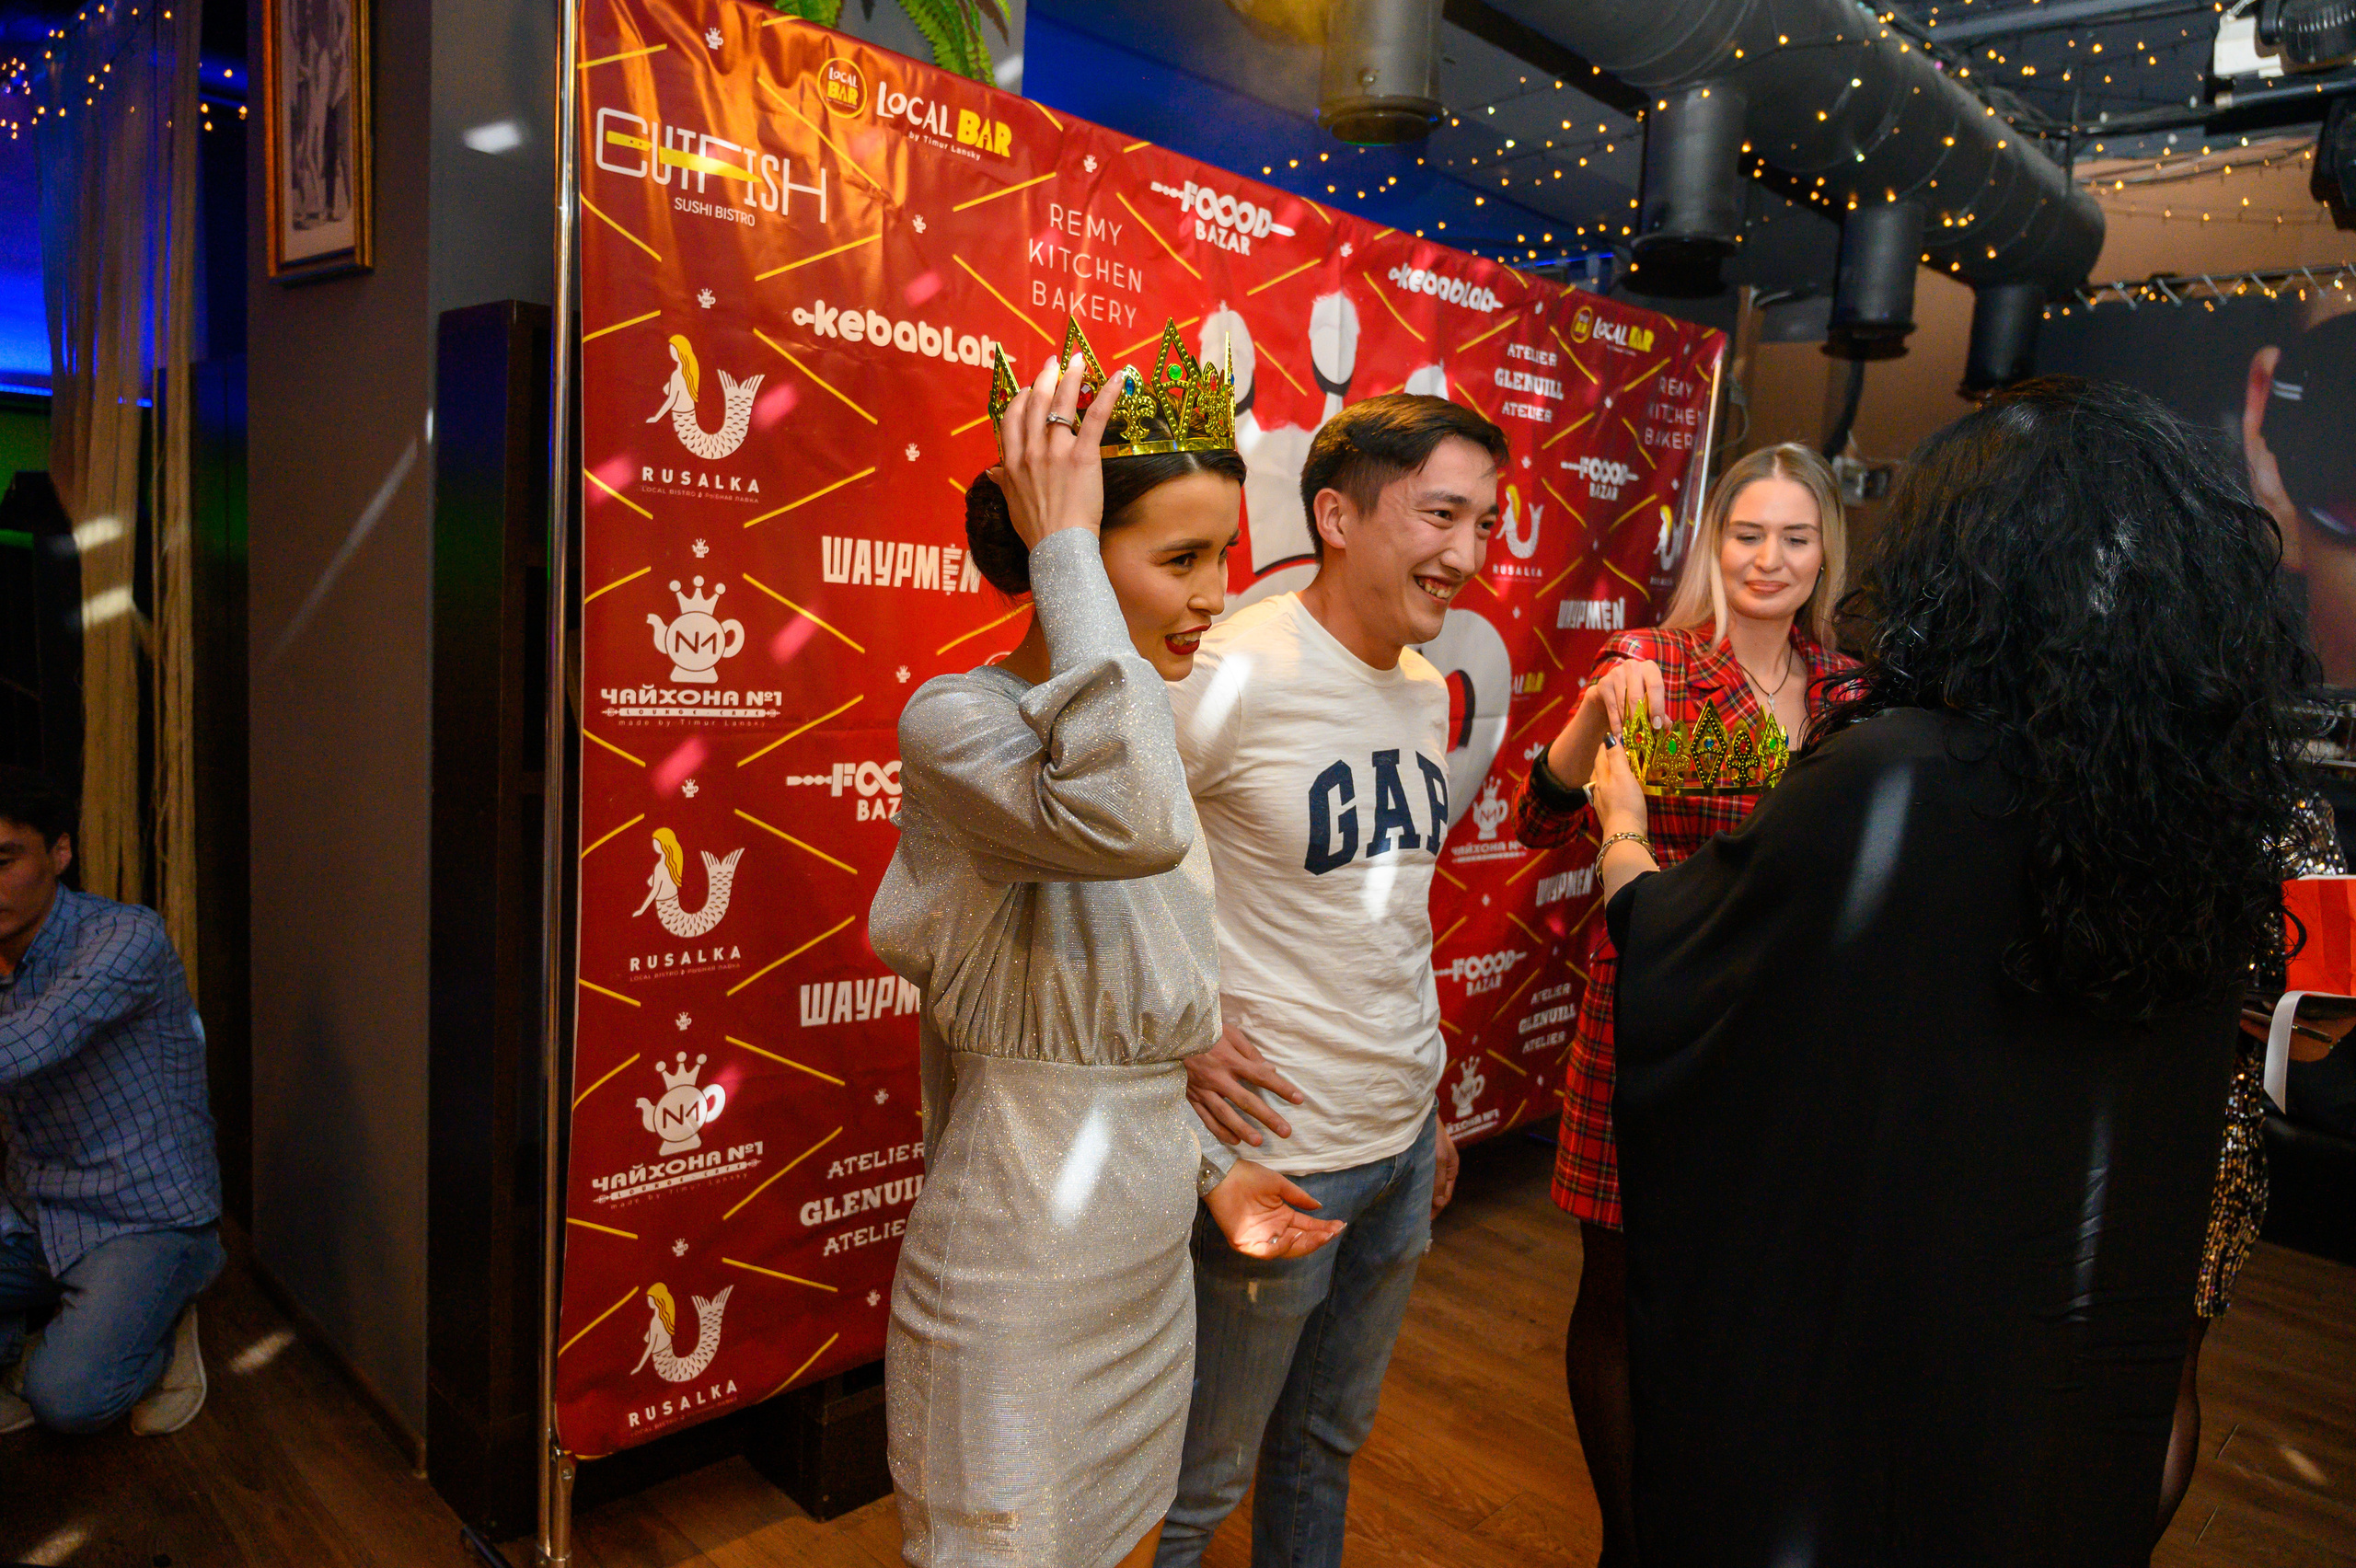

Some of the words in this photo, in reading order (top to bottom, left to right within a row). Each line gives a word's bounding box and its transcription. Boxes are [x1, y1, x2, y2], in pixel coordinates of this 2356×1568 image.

[829, 67, 858, 87] LOCAL
[827, 80, 859, 106] BAR
[877, 81, 953, 138] LOCAL
[956, 109, 1012, 158] BAR
[908, 131, 919, 142] by
[923, 135, 949, 150] Timur
[951, 144, 981, 161] Lansky
[675, 197, 712, 218] SUSHI
[715, 205, 756, 227] BISTRO
[1050, 203, 1122, 246] REMY
[1195, 220, 1251, 256] BAZAR
[1029, 238, 1142, 293] KITCHEN
[1033, 281, 1137, 329] BAKERY
[1507, 343, 1557, 366] ATELIER
[641, 467, 760, 494] RUSALKA
[641, 486, 666, 494] LOCAL
[601, 684, 739, 706] ЧАЙХОНА
[658, 720, 671, 728] by
[857, 797, 902, 822] BAZ
[629, 946, 741, 972] RUSALKA
[592, 1150, 722, 1192] ЧАЙХОНА
[823, 1218, 906, 1257] ATELIE
[629, 1379, 737, 1427] RUSALKA
